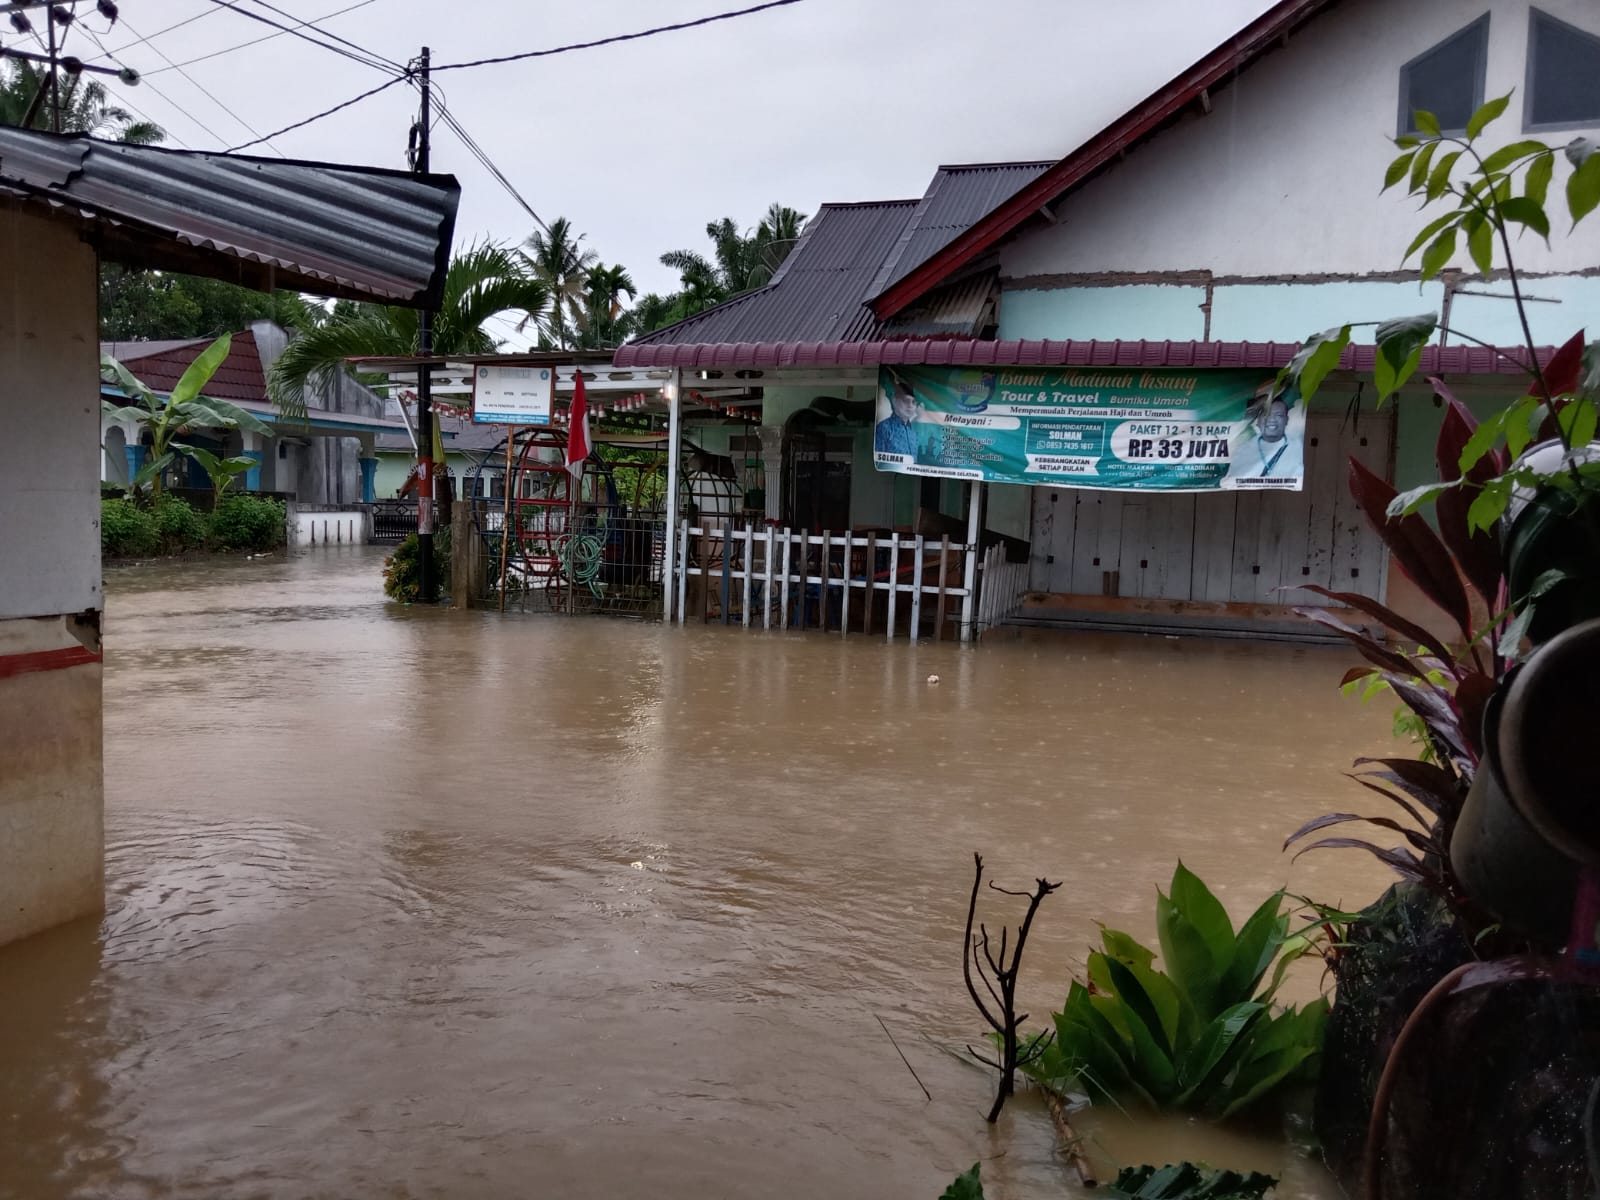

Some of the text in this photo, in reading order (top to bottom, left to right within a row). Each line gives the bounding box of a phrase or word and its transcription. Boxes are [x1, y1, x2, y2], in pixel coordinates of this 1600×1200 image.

[1000, 369, 1047, 386] Bumi
[1051, 369, 1133, 388] Madinah
[1001, 391, 1099, 403] Tour & Travel
[1110, 395, 1189, 406] Bumiku Umroh
[1010, 406, 1173, 418] Mempermudah Perjalanan Haji dan Umroh
[944, 414, 986, 426] Melayani
[1129, 424, 1161, 434] PAKET
[1166, 425, 1178, 434] 12
[1190, 426, 1202, 435] 13
[1206, 425, 1231, 435] HARI
[1049, 431, 1082, 440] SOLMAN
[1128, 439, 1229, 458] RP. 33 JUTA
[877, 453, 904, 463] SOLMAN
[1035, 457, 1090, 465] KEBERANGKATAN
